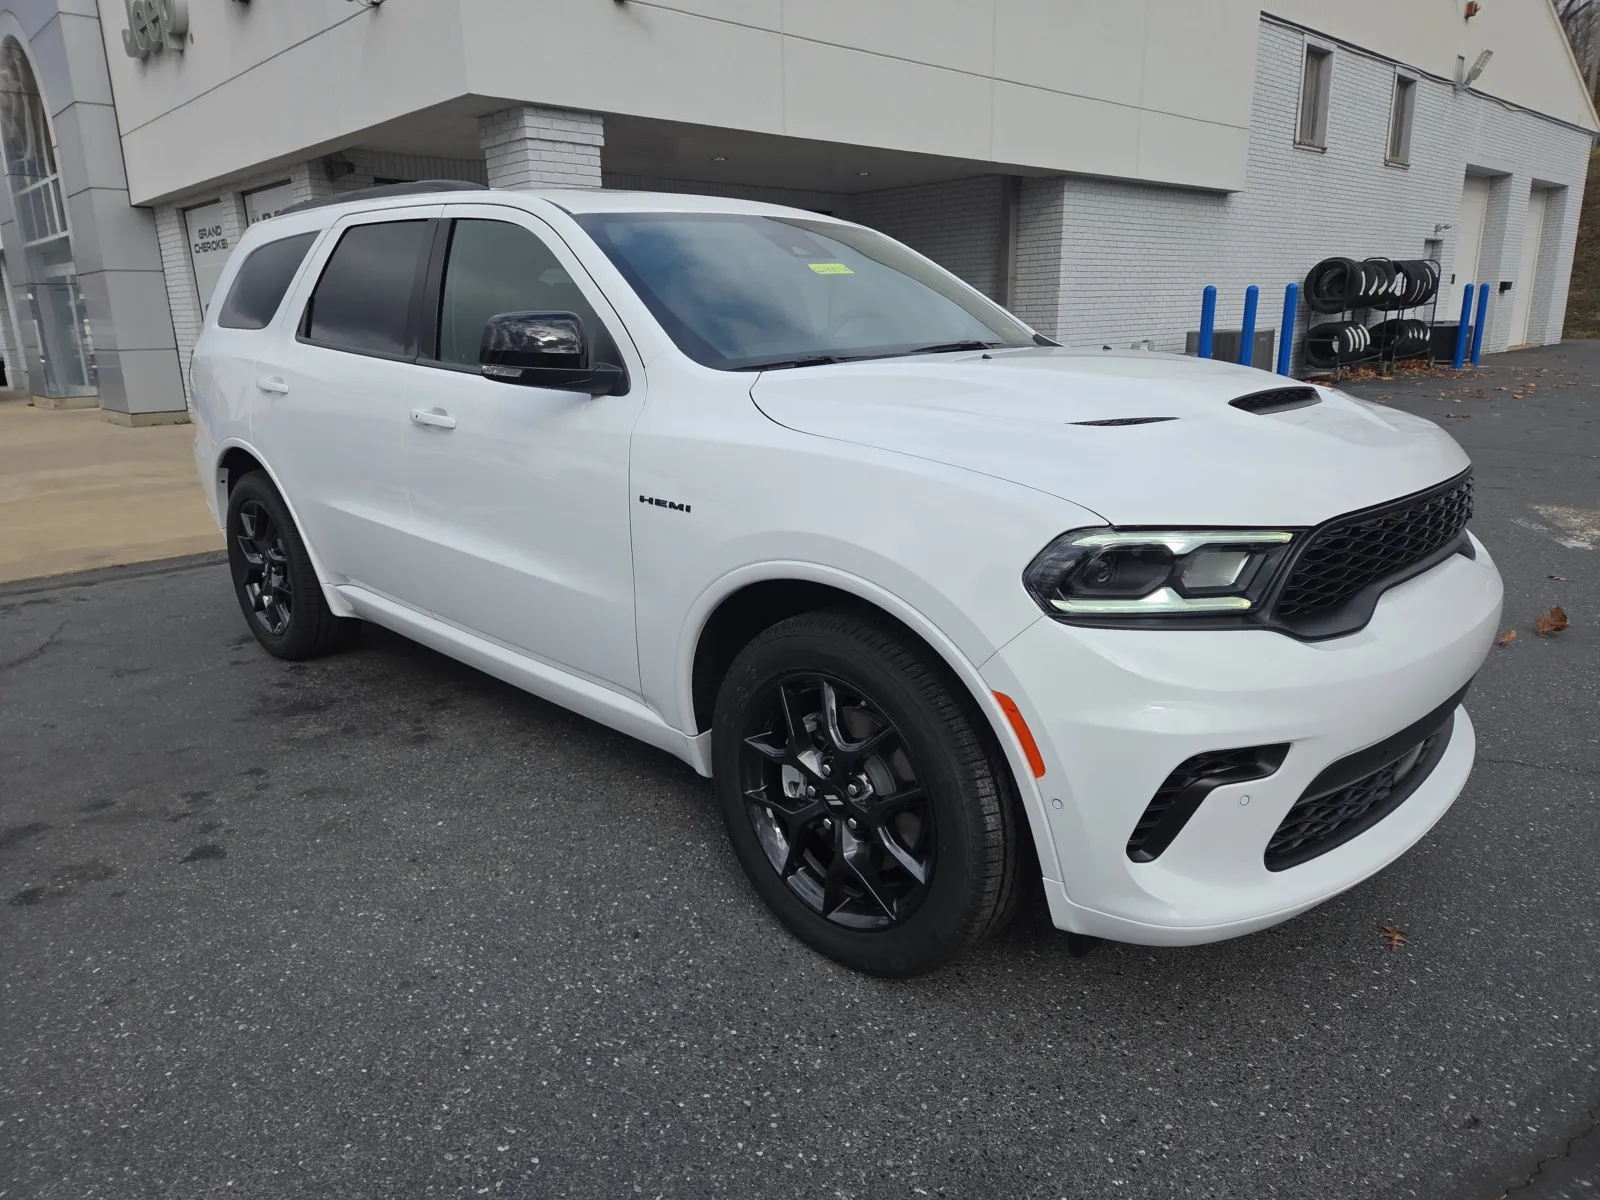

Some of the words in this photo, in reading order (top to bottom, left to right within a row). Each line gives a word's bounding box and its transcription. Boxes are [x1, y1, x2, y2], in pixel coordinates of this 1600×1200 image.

[122, 0, 186, 58] Jeep
[198, 225, 222, 239] GRAND
[639, 495, 691, 513] HEMI
